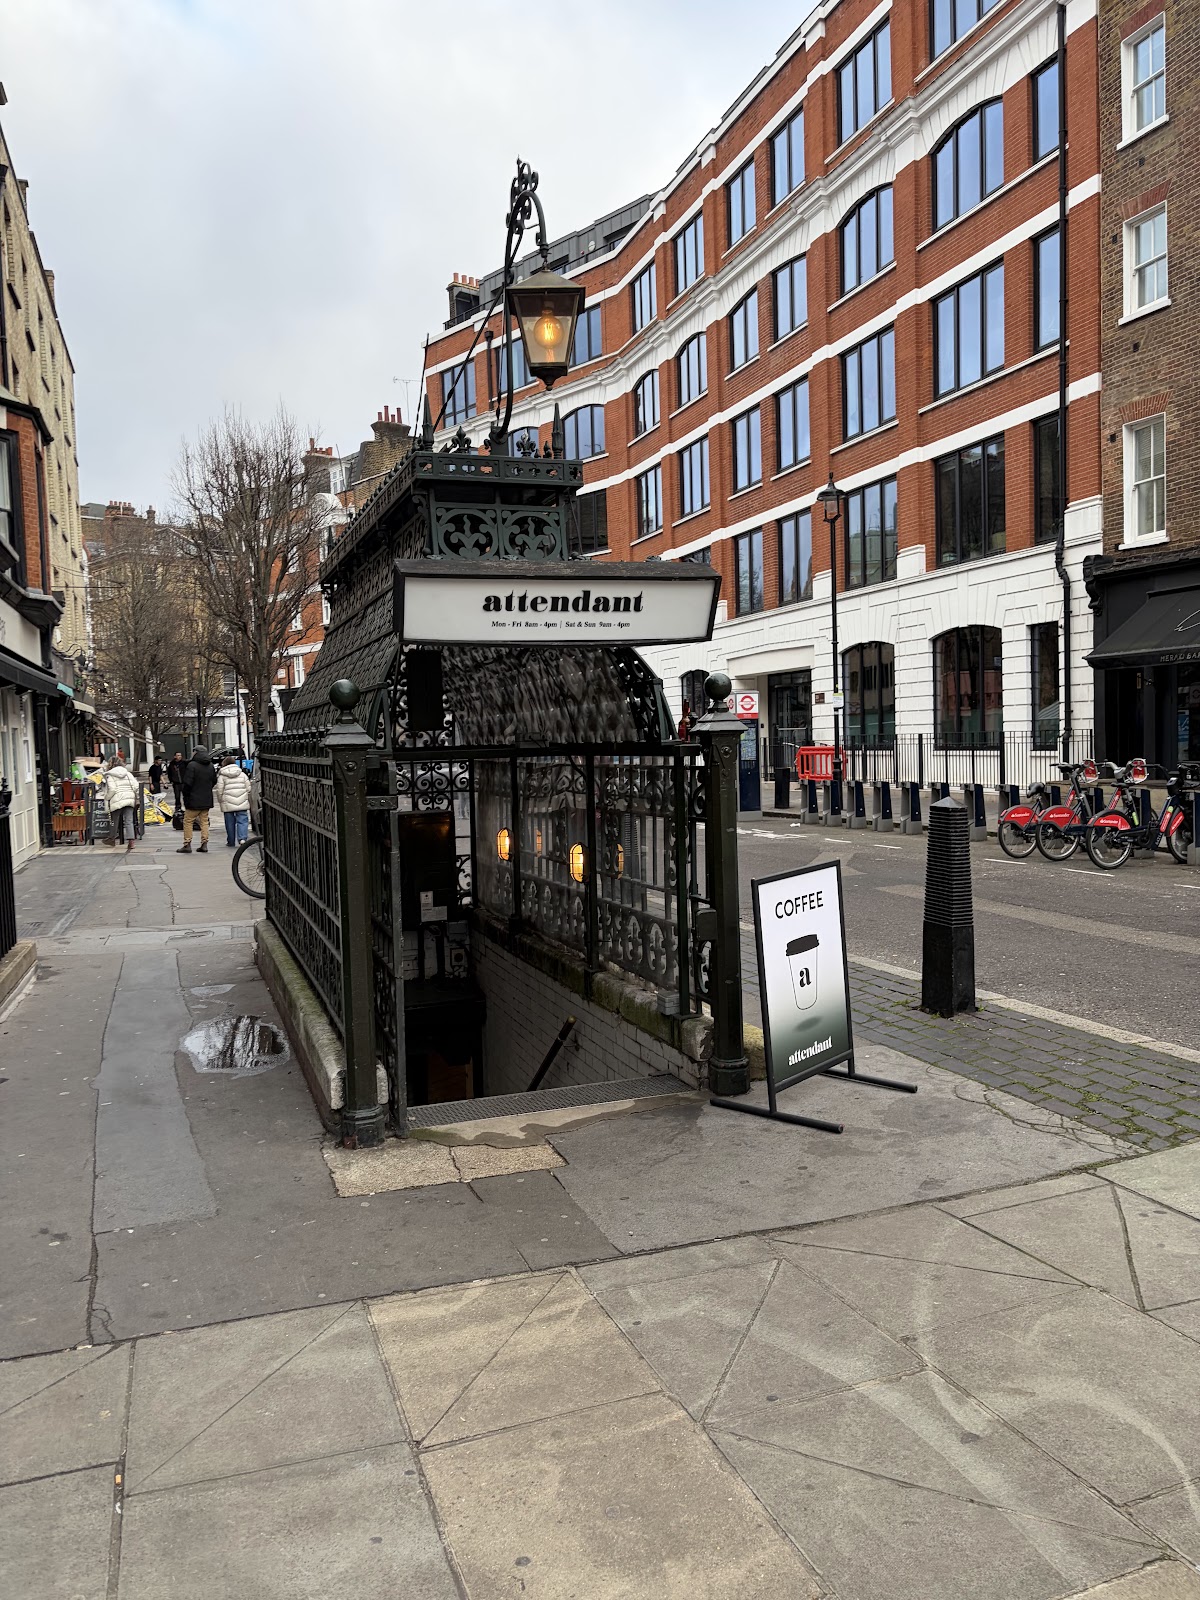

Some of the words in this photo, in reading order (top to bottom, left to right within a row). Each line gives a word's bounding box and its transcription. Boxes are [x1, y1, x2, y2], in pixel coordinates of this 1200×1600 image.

[482, 589, 644, 612] attendant
[491, 620, 507, 628] Mon
[512, 620, 522, 628] Fri
[543, 621, 558, 629] 4pm
[617, 621, 631, 629] 4pm
[775, 890, 824, 919] COFFEE
[799, 967, 812, 988] a
[788, 1036, 833, 1066] attendant
